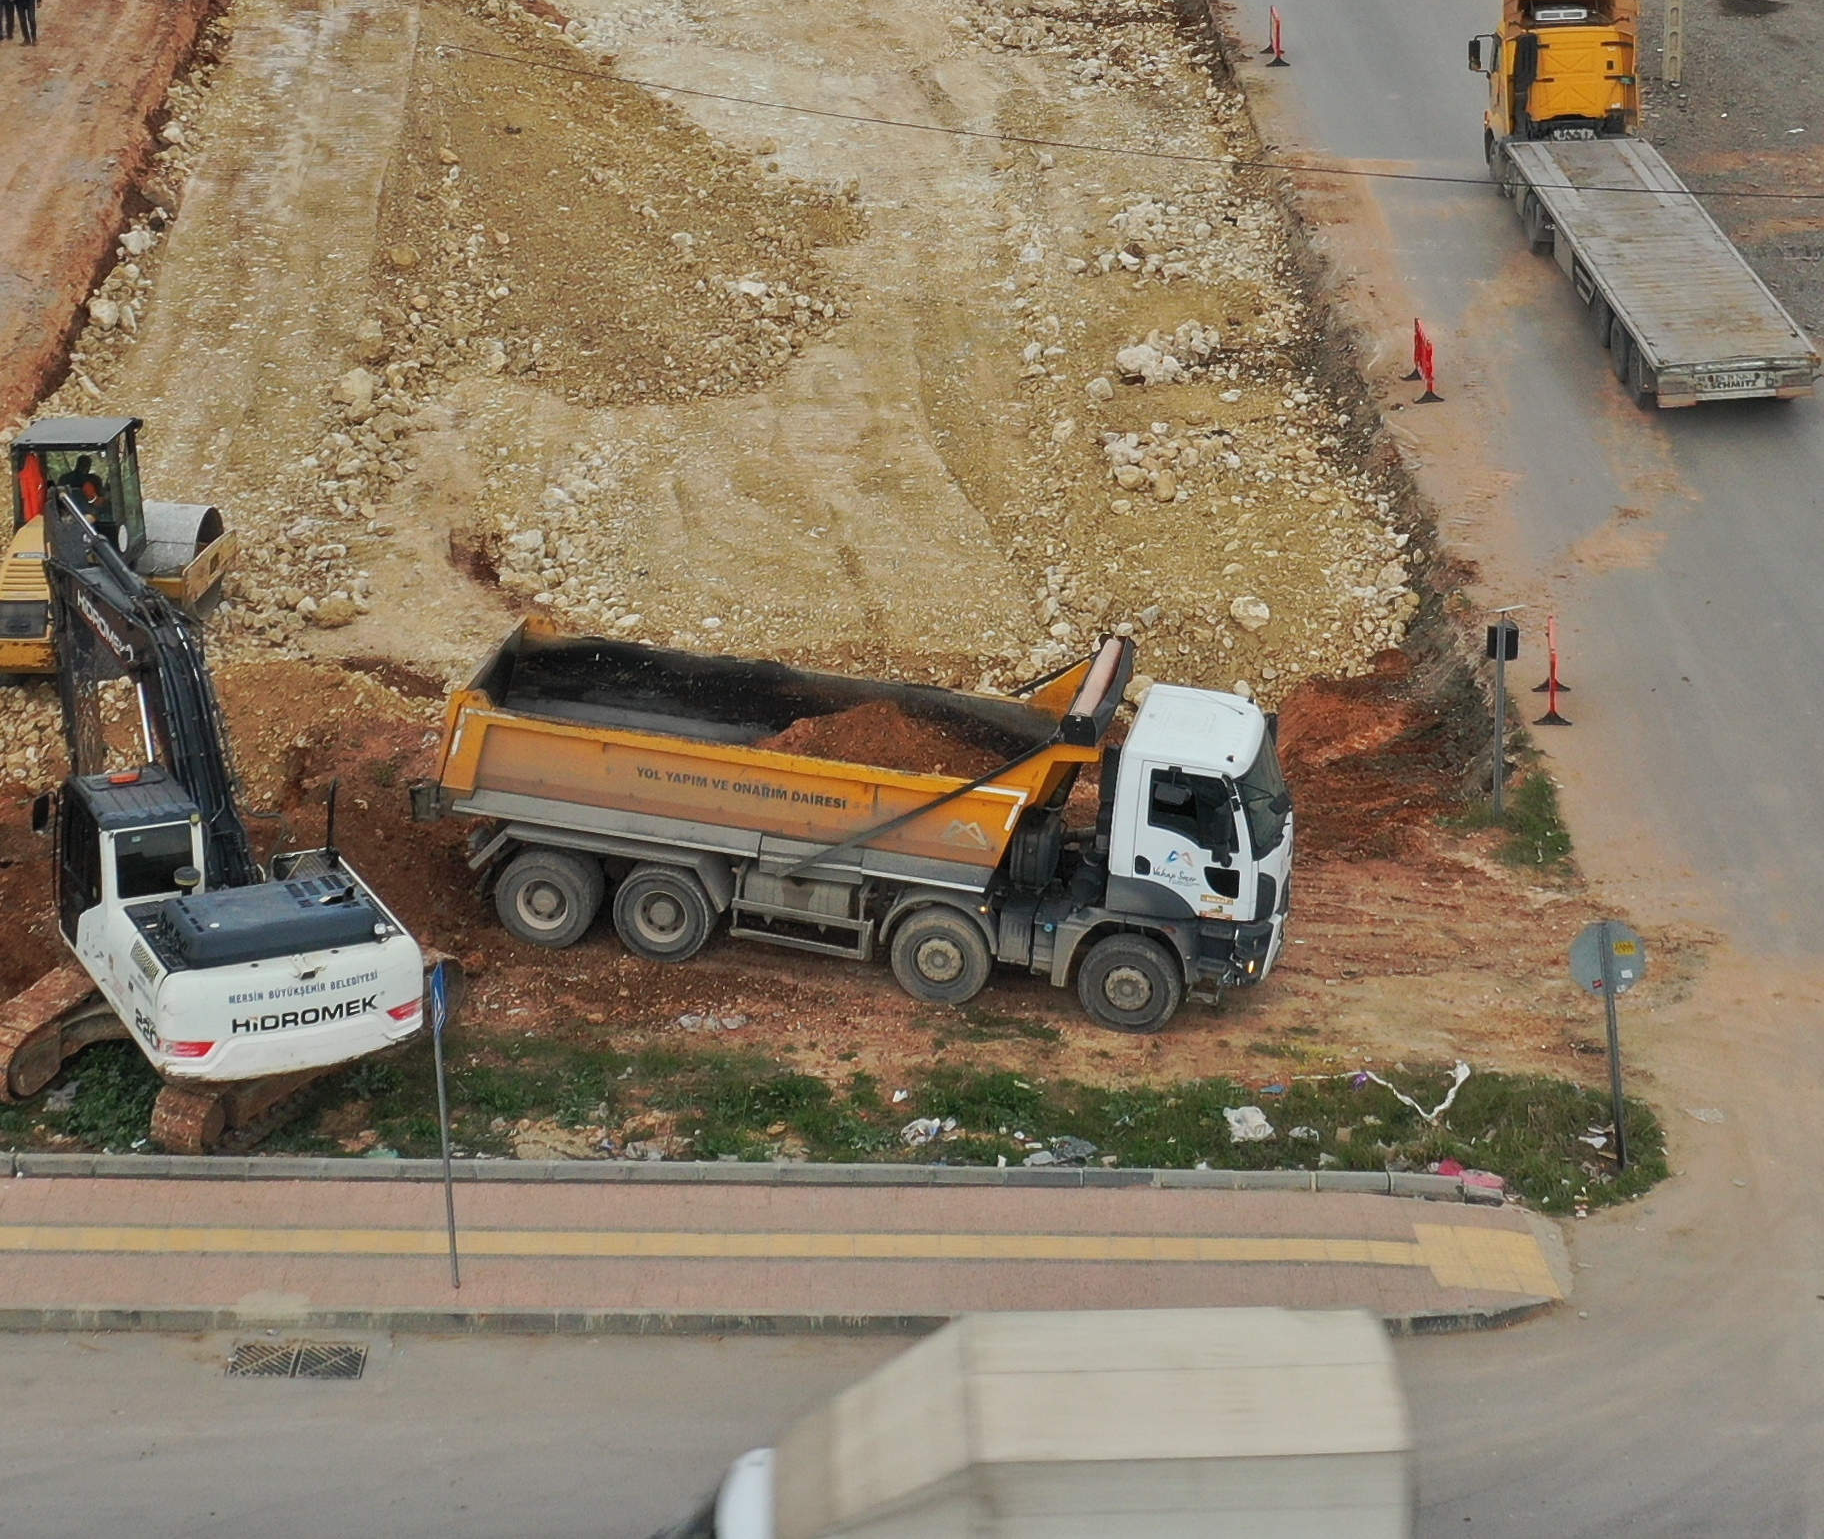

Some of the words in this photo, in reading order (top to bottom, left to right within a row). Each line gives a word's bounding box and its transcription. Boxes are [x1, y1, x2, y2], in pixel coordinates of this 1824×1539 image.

[1710, 379, 1757, 390] SCHMITZ
[636, 766, 661, 782] YOL
[665, 770, 708, 789] YAPIM
[712, 778, 729, 791] VE
[732, 781, 788, 801] ONARIM
[791, 790, 848, 810] DAİRESİ
[228, 989, 264, 1005] MERSİN
[268, 981, 326, 1000] BÜYÜKŞEHİR
[330, 969, 378, 990] BELEDİYESİ
